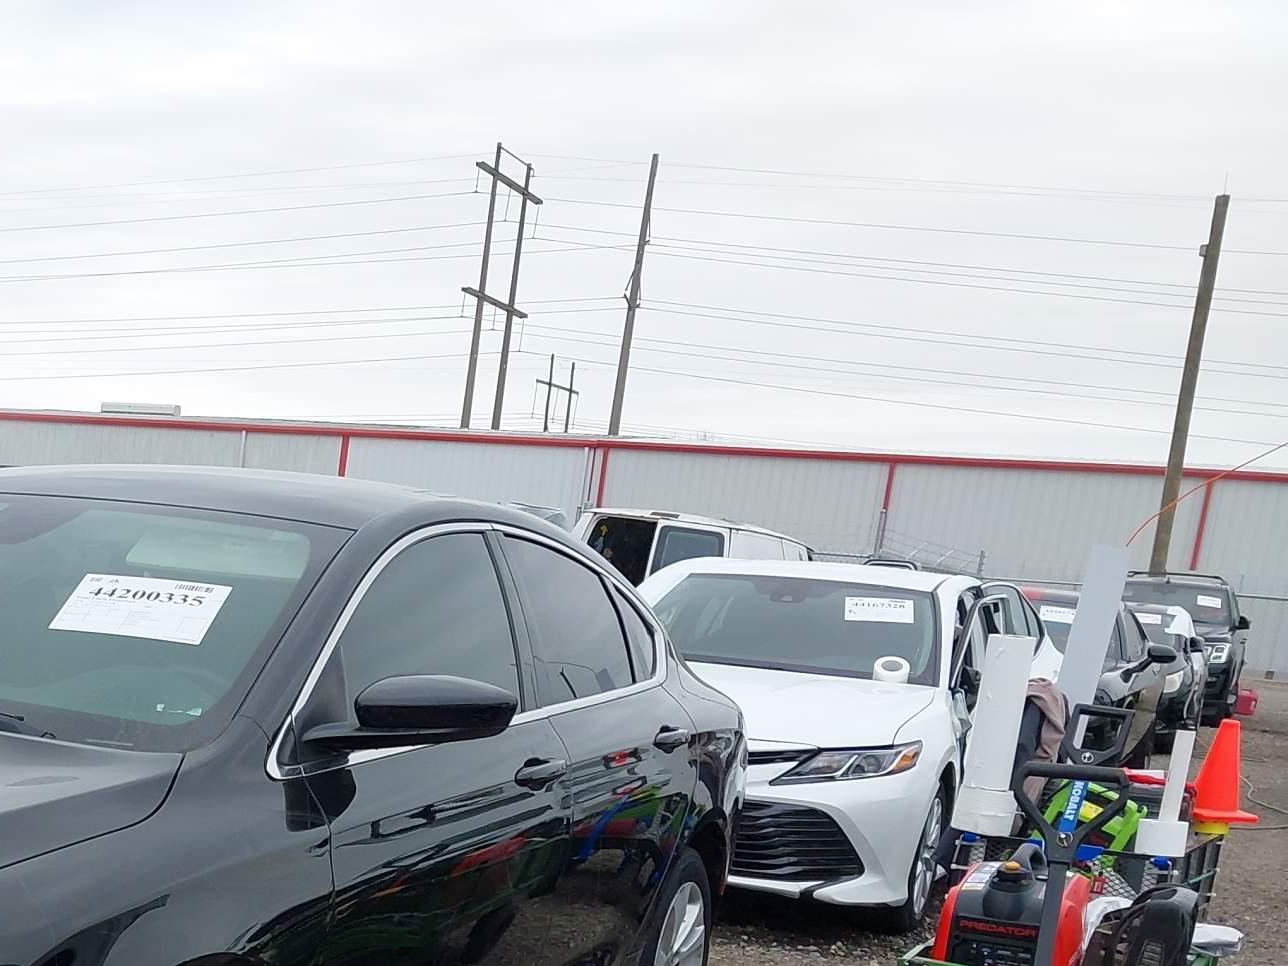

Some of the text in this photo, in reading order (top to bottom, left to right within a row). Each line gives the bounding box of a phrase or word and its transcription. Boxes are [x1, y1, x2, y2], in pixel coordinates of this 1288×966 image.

[89, 586, 208, 607] 44200335
[1063, 781, 1085, 821] KOBALT
[959, 919, 1037, 937] PREDATOR
